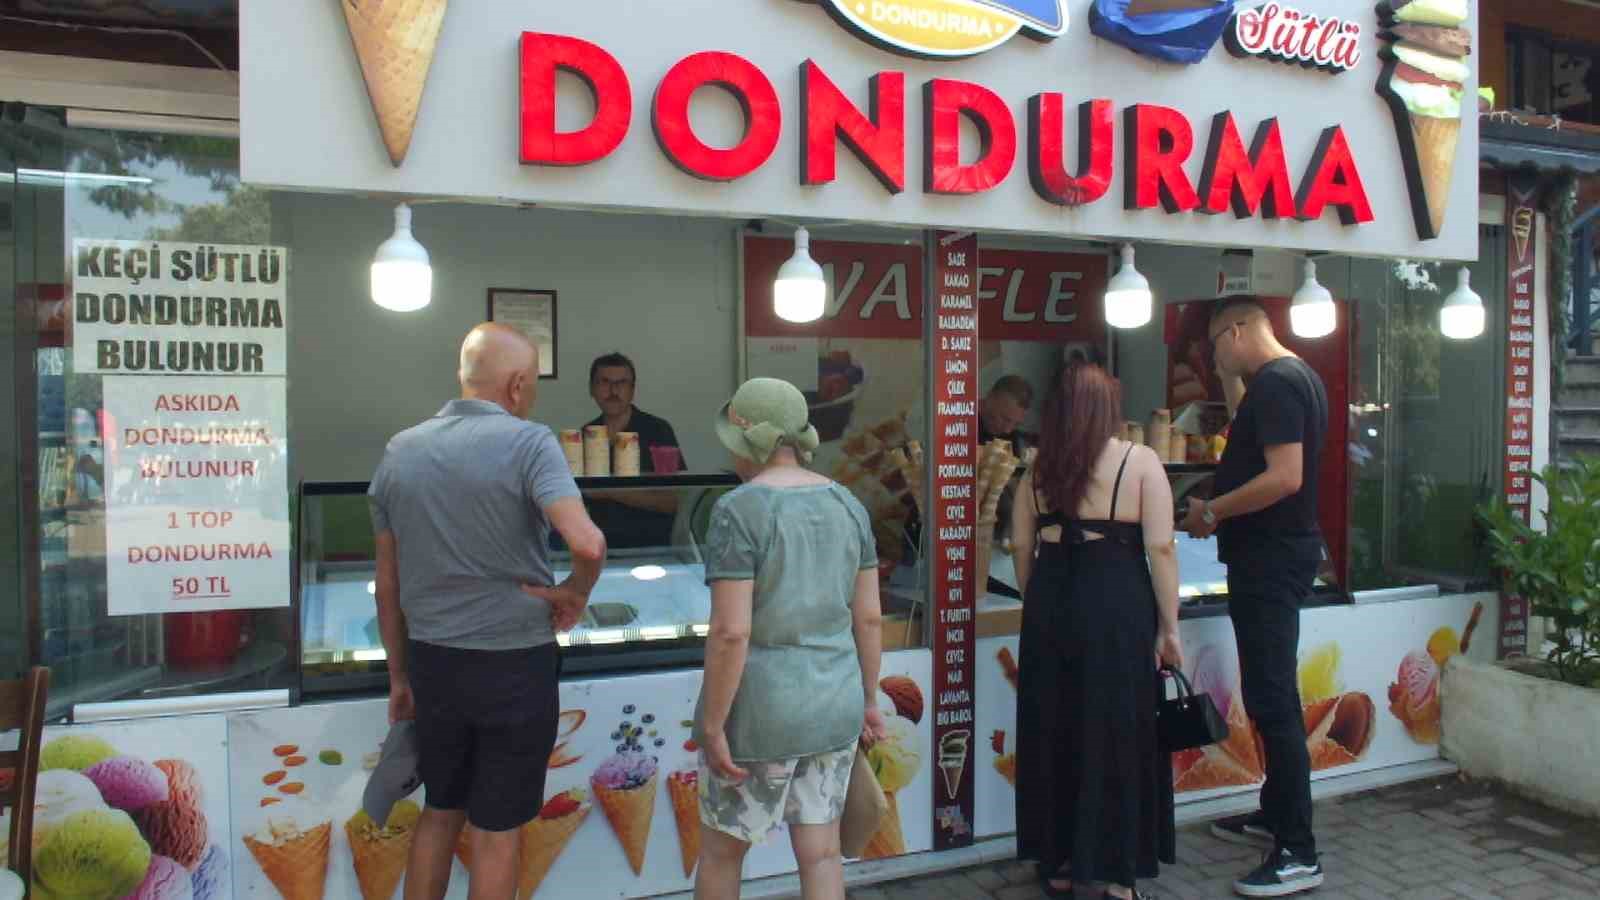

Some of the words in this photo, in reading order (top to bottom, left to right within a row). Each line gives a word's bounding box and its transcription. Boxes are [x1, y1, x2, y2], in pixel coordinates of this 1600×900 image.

[872, 3, 992, 37] DONDURMA
[1239, 3, 1360, 68] Sütlü
[519, 30, 1375, 225] DONDURMA
[77, 243, 161, 285] KEÇİ
[171, 246, 280, 284] SÜTLÜ
[947, 252, 966, 267] SADE
[944, 272, 969, 288] KAKAO
[76, 293, 283, 328] DONDURMA
[941, 294, 972, 309] KARAMEL
[97, 339, 264, 372] BULUNUR
[154, 394, 240, 412] ASKIDA
[938, 401, 975, 416] FRAMBUAZ
[124, 428, 270, 447] DONDURMA
[140, 459, 255, 479] BULUNUR
[938, 464, 974, 478] PORTAKAL
[941, 484, 971, 498] KESTANE
[168, 512, 179, 529] 1
[187, 511, 233, 529] TOP
[127, 542, 272, 564] DONDURMA
[172, 577, 199, 595] 50
[206, 576, 231, 594] TL
